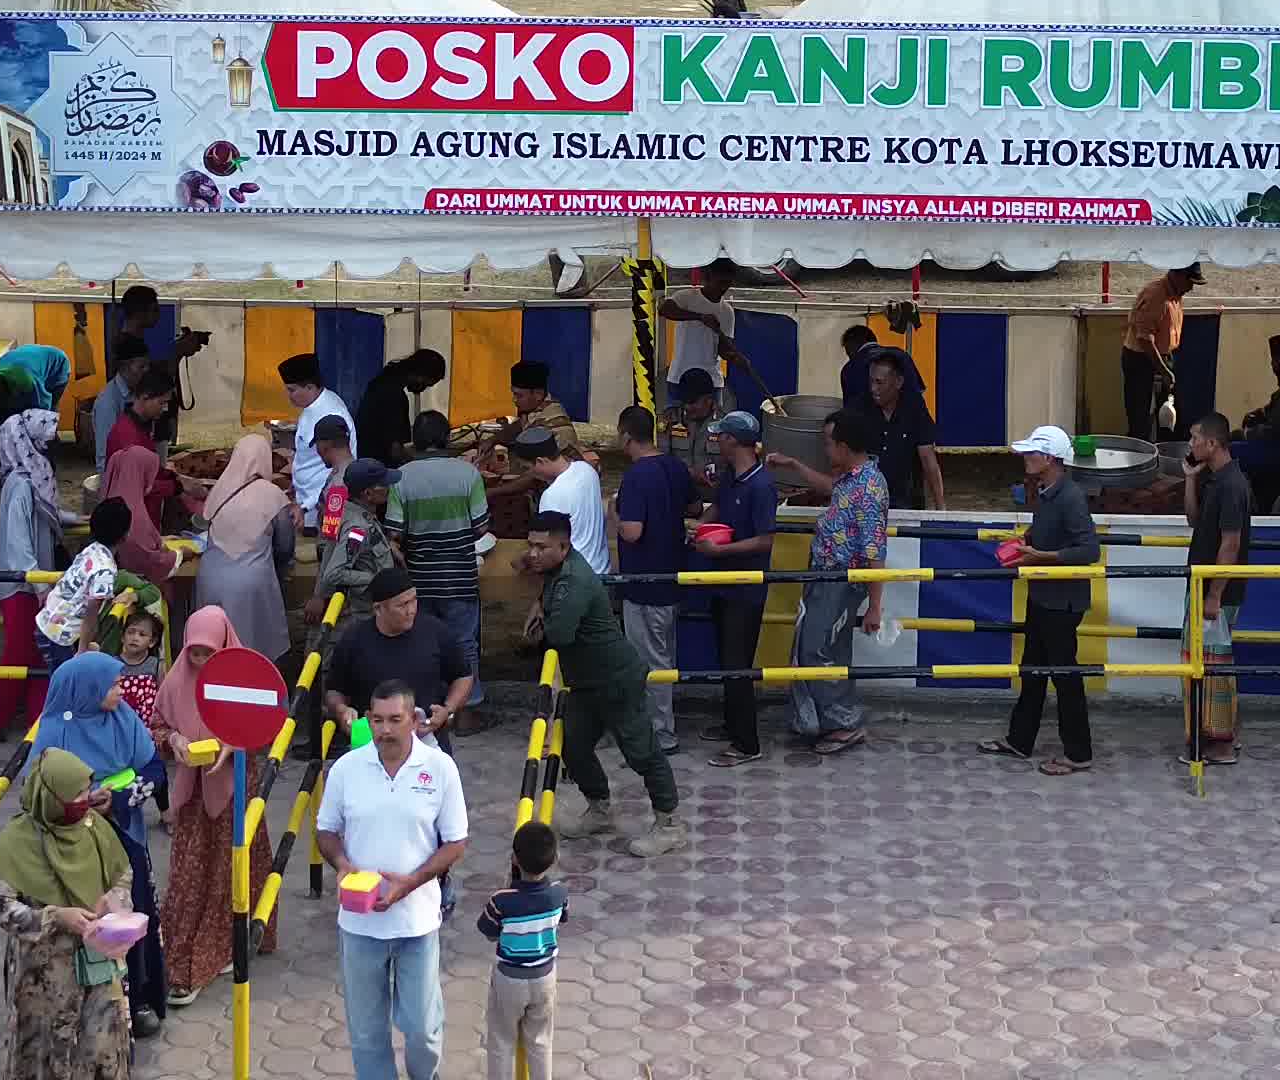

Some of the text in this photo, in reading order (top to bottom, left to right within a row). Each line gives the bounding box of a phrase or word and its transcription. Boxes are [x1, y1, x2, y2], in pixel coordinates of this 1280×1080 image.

[296, 29, 631, 102] POSKO
[660, 32, 951, 107] KANJI
[65, 150, 162, 162] 1445 H/2024 M
[257, 129, 399, 158] MASJID
[410, 131, 538, 159] AGUNG
[553, 133, 706, 161] ISLAMIC
[720, 134, 871, 163] CENTRE
[883, 136, 994, 165] KOTA
[436, 193, 1141, 218] DARI UMMAT UNTUK UMMAT KARENA UMMAT, INSYA ALLAH DIBERI RAHMAT
